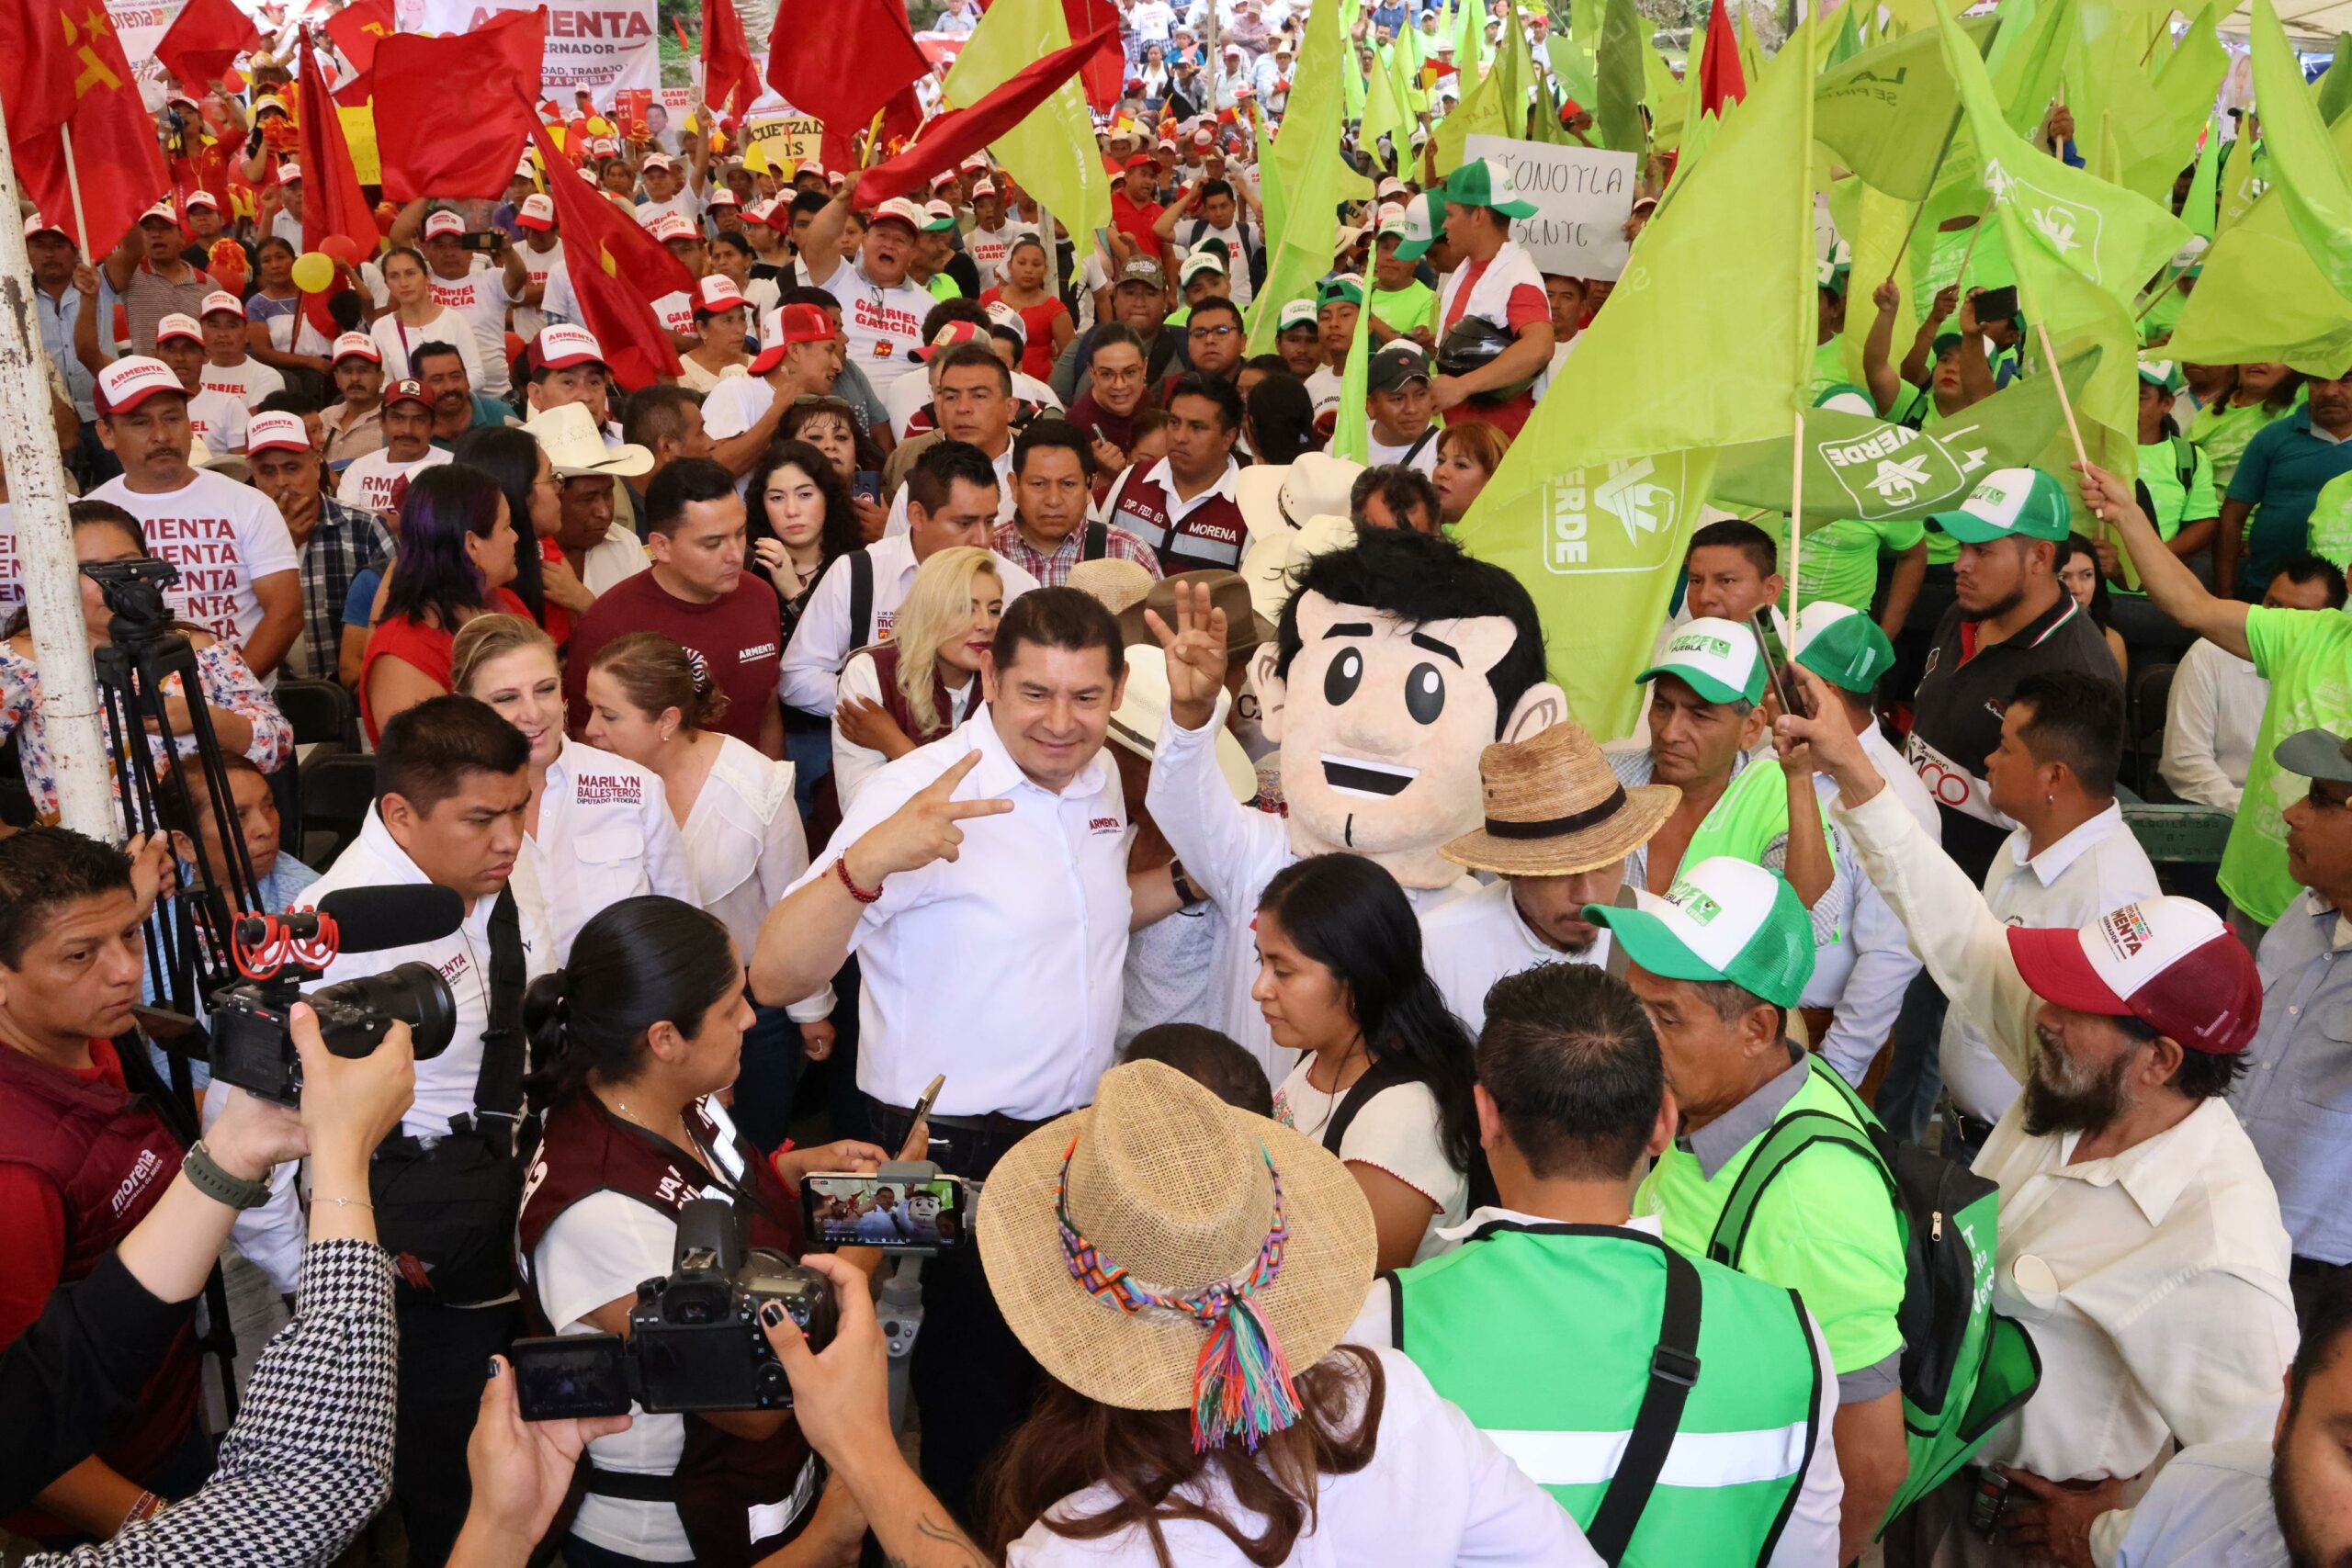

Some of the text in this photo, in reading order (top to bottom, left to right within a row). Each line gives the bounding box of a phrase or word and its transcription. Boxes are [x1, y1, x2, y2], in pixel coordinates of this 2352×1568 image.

[110, 9, 153, 30] orena
[467, 7, 652, 39] AENTA
[571, 64, 623, 74] TRABAJO
[665, 98, 687, 107] GAR
[855, 299, 919, 326] GABRIEL
[855, 313, 917, 337] GARCÍA
[110, 365, 164, 388] ARMENTA
[201, 381, 247, 394] BRIEL
[252, 420, 293, 434] ARMENTA
[1826, 424, 1920, 467] VERDE
[1124, 499, 1164, 524] DIP. FED. 03
[1189, 521, 1237, 542] MORENA
[578, 773, 640, 788] MARILYN
[577, 786, 641, 798] BALLESTEROS
[612, 797, 641, 806] FEDERAL
[1090, 817, 1120, 830] ARMENTA
[1664, 891, 1681, 908] EBLA
[110, 1149, 156, 1212] morena
[116, 1159, 164, 1219] La esperanza de México
[1973, 1249, 1987, 1275] nta
